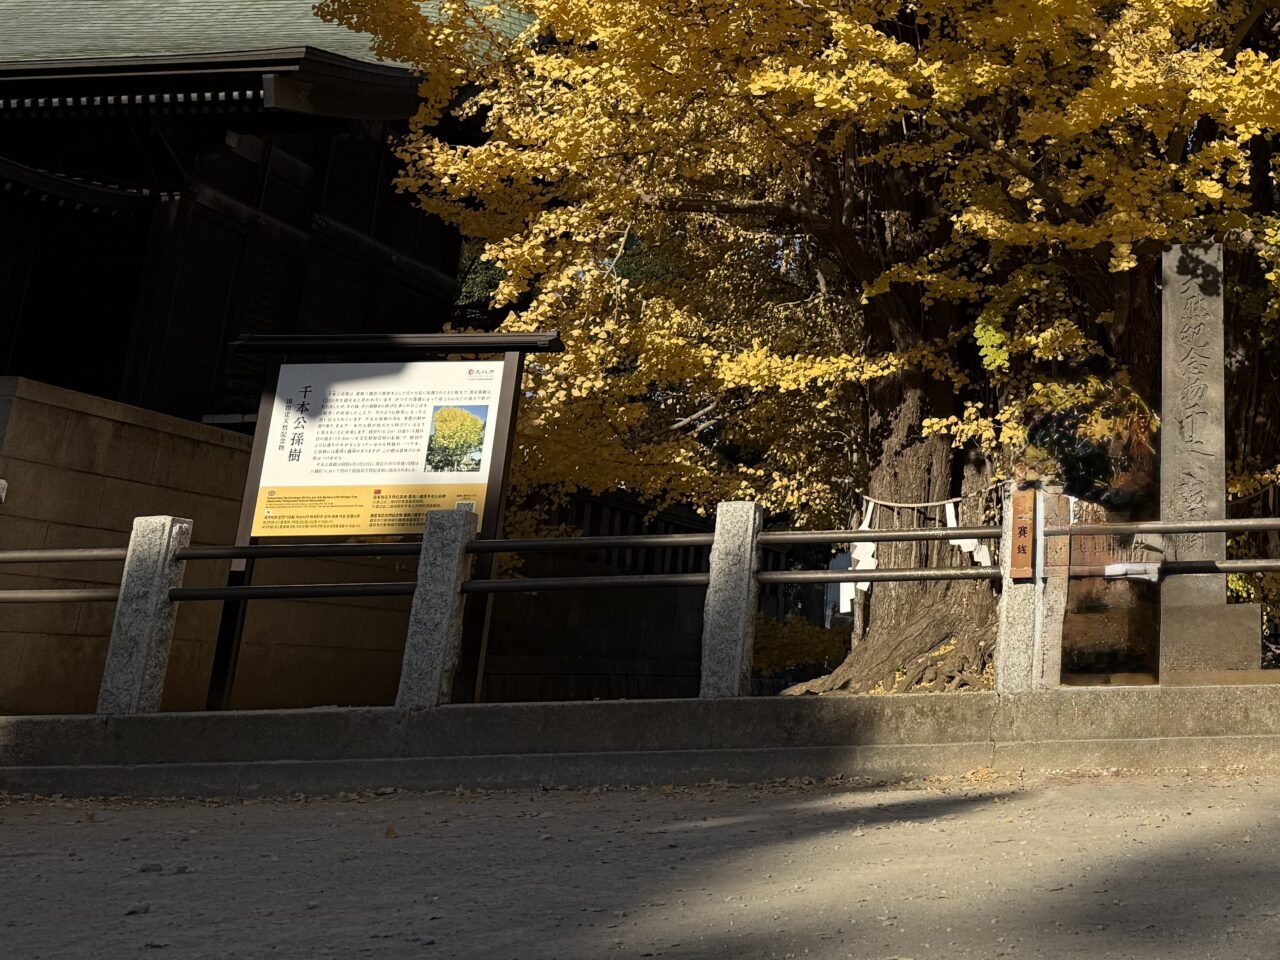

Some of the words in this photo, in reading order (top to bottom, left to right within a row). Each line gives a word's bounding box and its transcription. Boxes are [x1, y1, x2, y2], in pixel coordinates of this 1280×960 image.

[288, 385, 313, 462] 千本公孫樹
